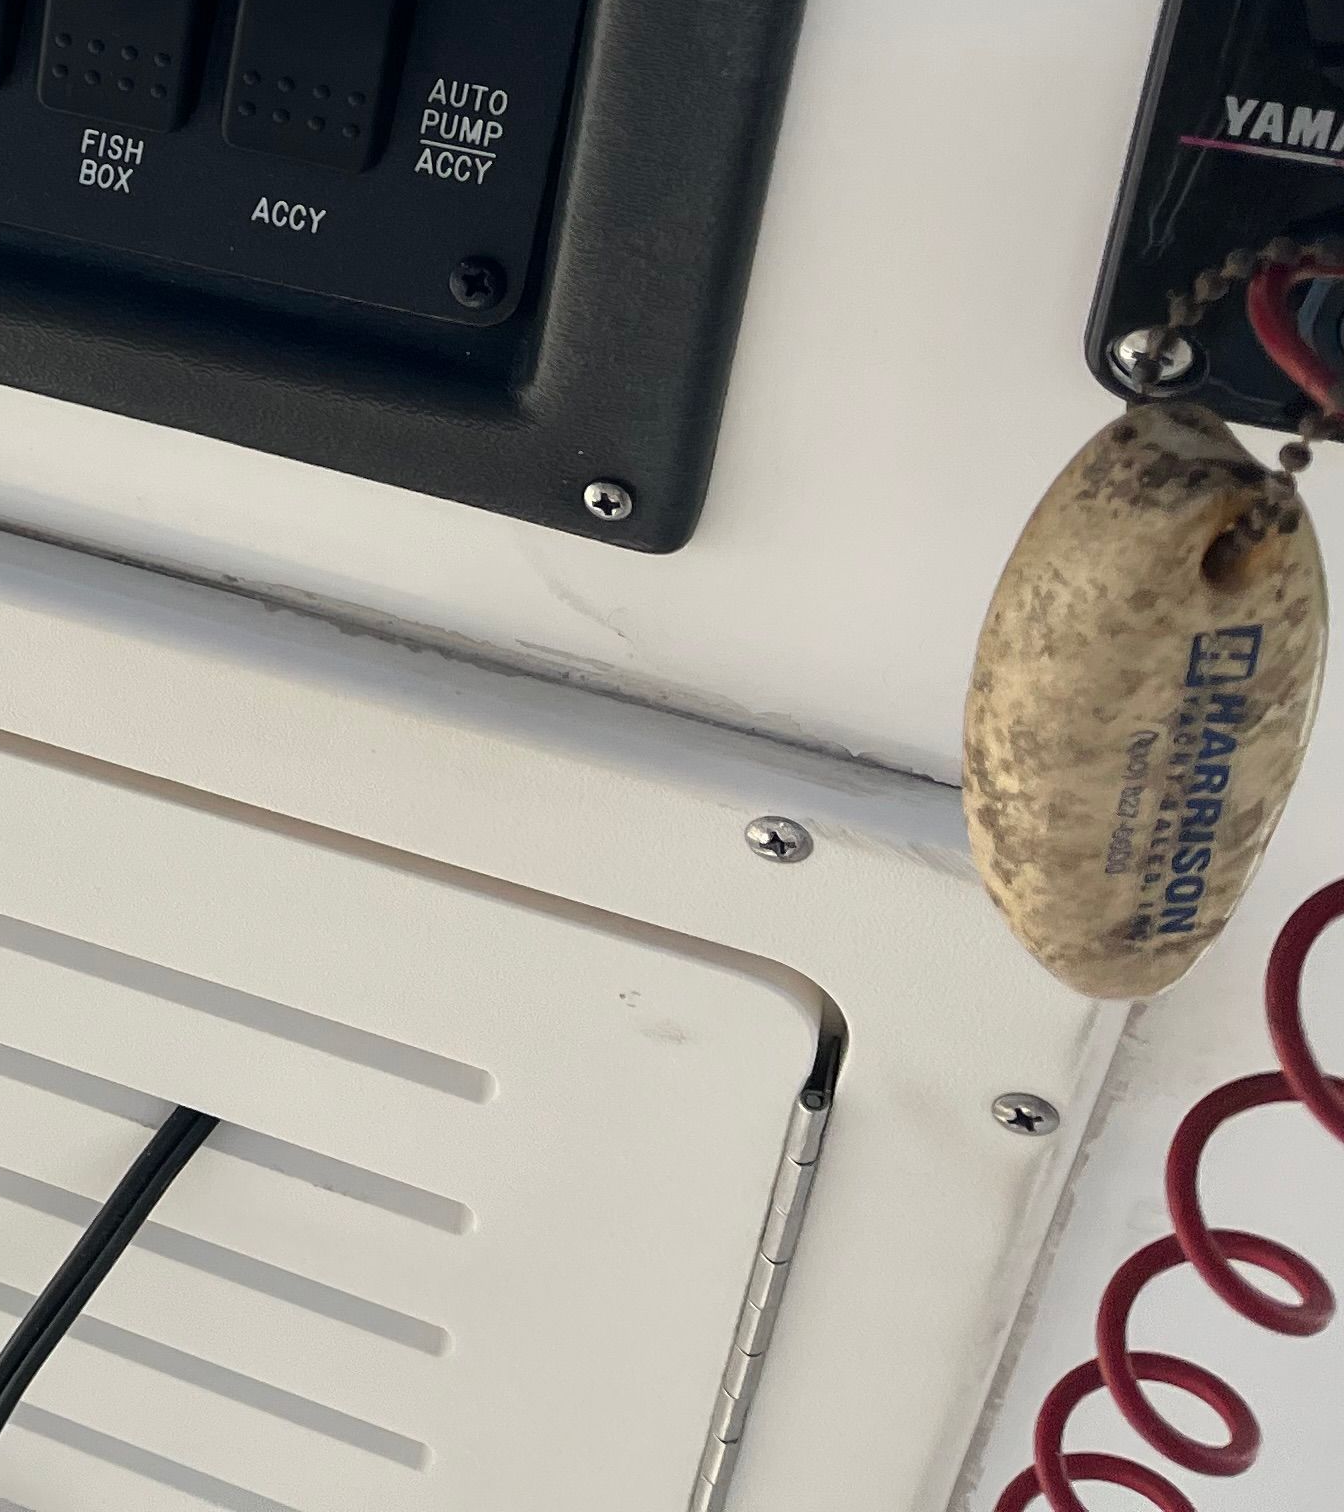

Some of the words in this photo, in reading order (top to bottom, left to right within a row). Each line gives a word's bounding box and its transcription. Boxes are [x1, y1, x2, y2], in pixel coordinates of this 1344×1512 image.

[428, 78, 508, 116] AUTO
[80, 128, 144, 165] FISH
[420, 109, 503, 147] PUMP
[78, 158, 134, 194] BOX
[414, 148, 494, 185] ACCY
[251, 197, 327, 234] ACCY
[1157, 692, 1245, 935] HARRISON
